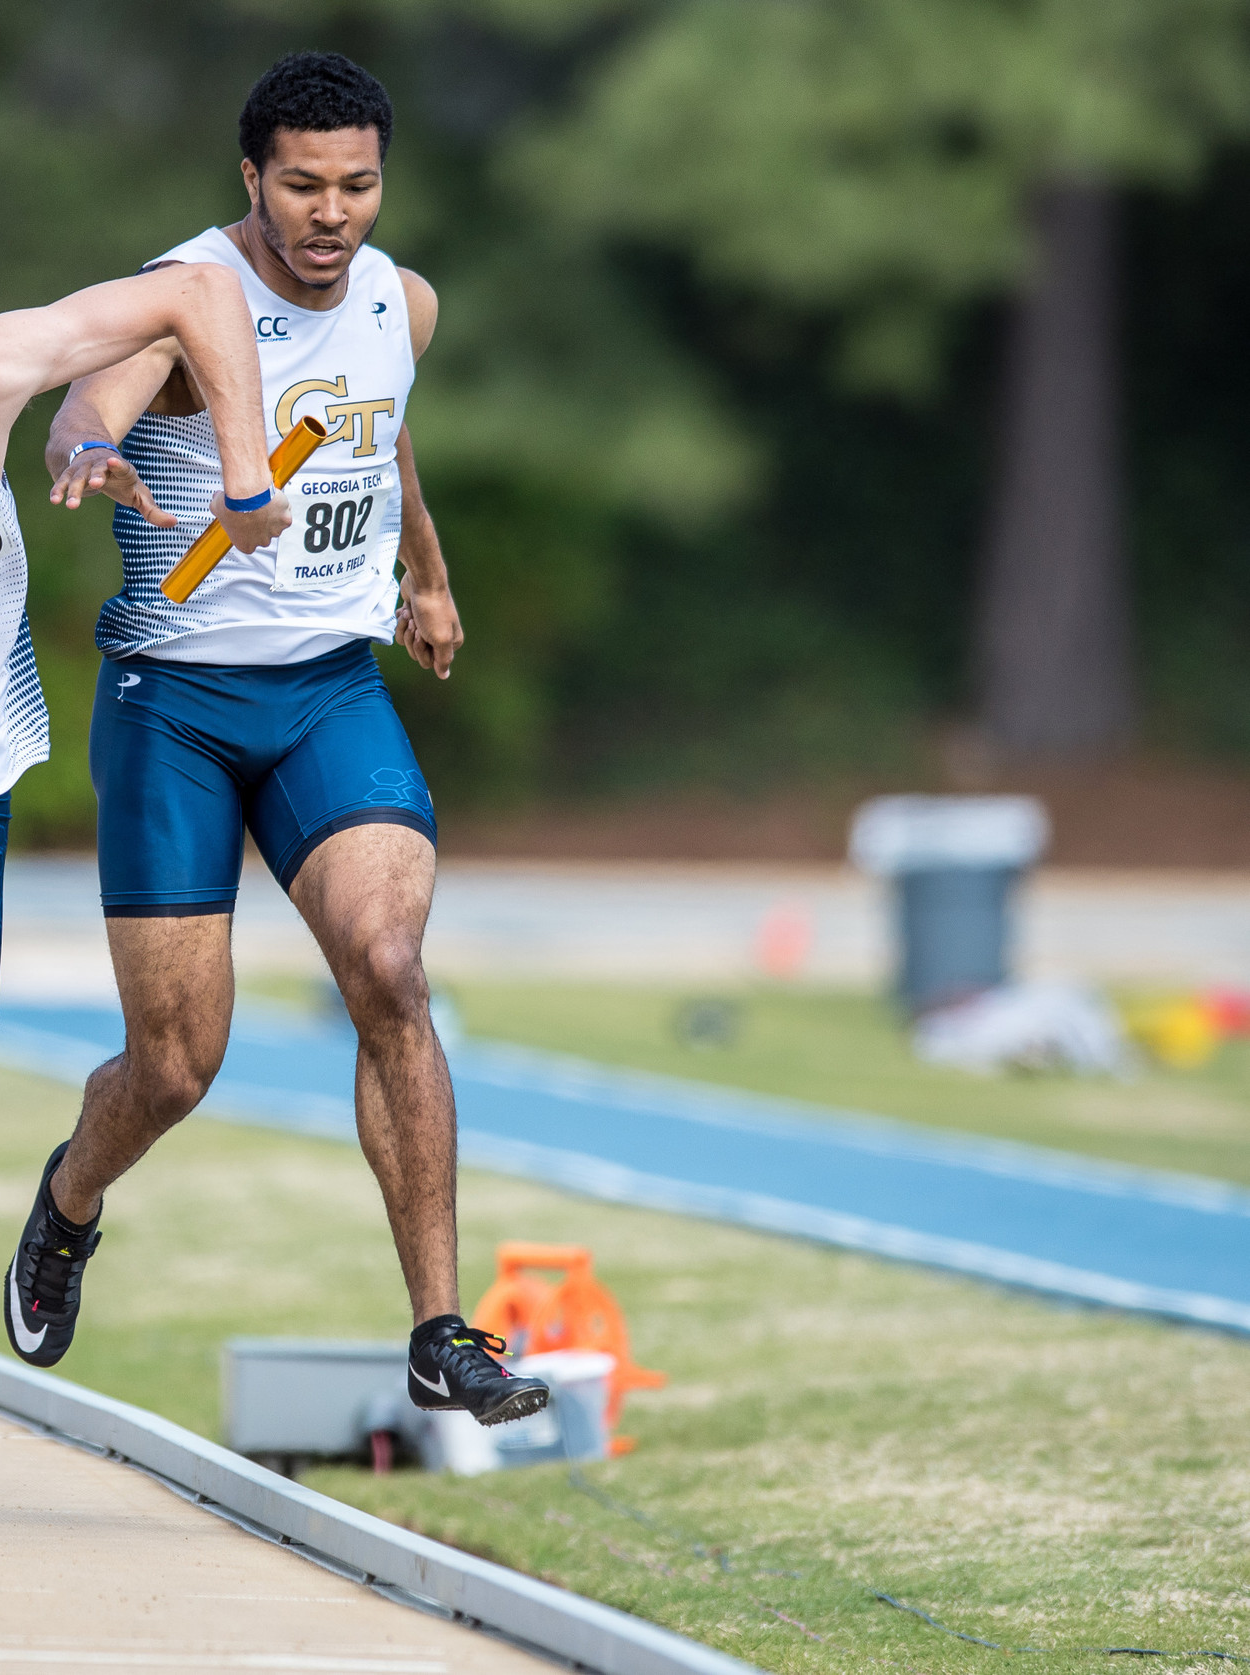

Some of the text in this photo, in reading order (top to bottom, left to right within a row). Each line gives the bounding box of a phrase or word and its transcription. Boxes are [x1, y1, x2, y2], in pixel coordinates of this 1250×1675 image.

[254, 316, 289, 338] CC
[301, 473, 383, 496] GEORGIA TECH
[303, 495, 374, 554] 802
[294, 563, 335, 579] TRACK
[336, 561, 344, 574] &
[346, 554, 366, 571] FIELD
